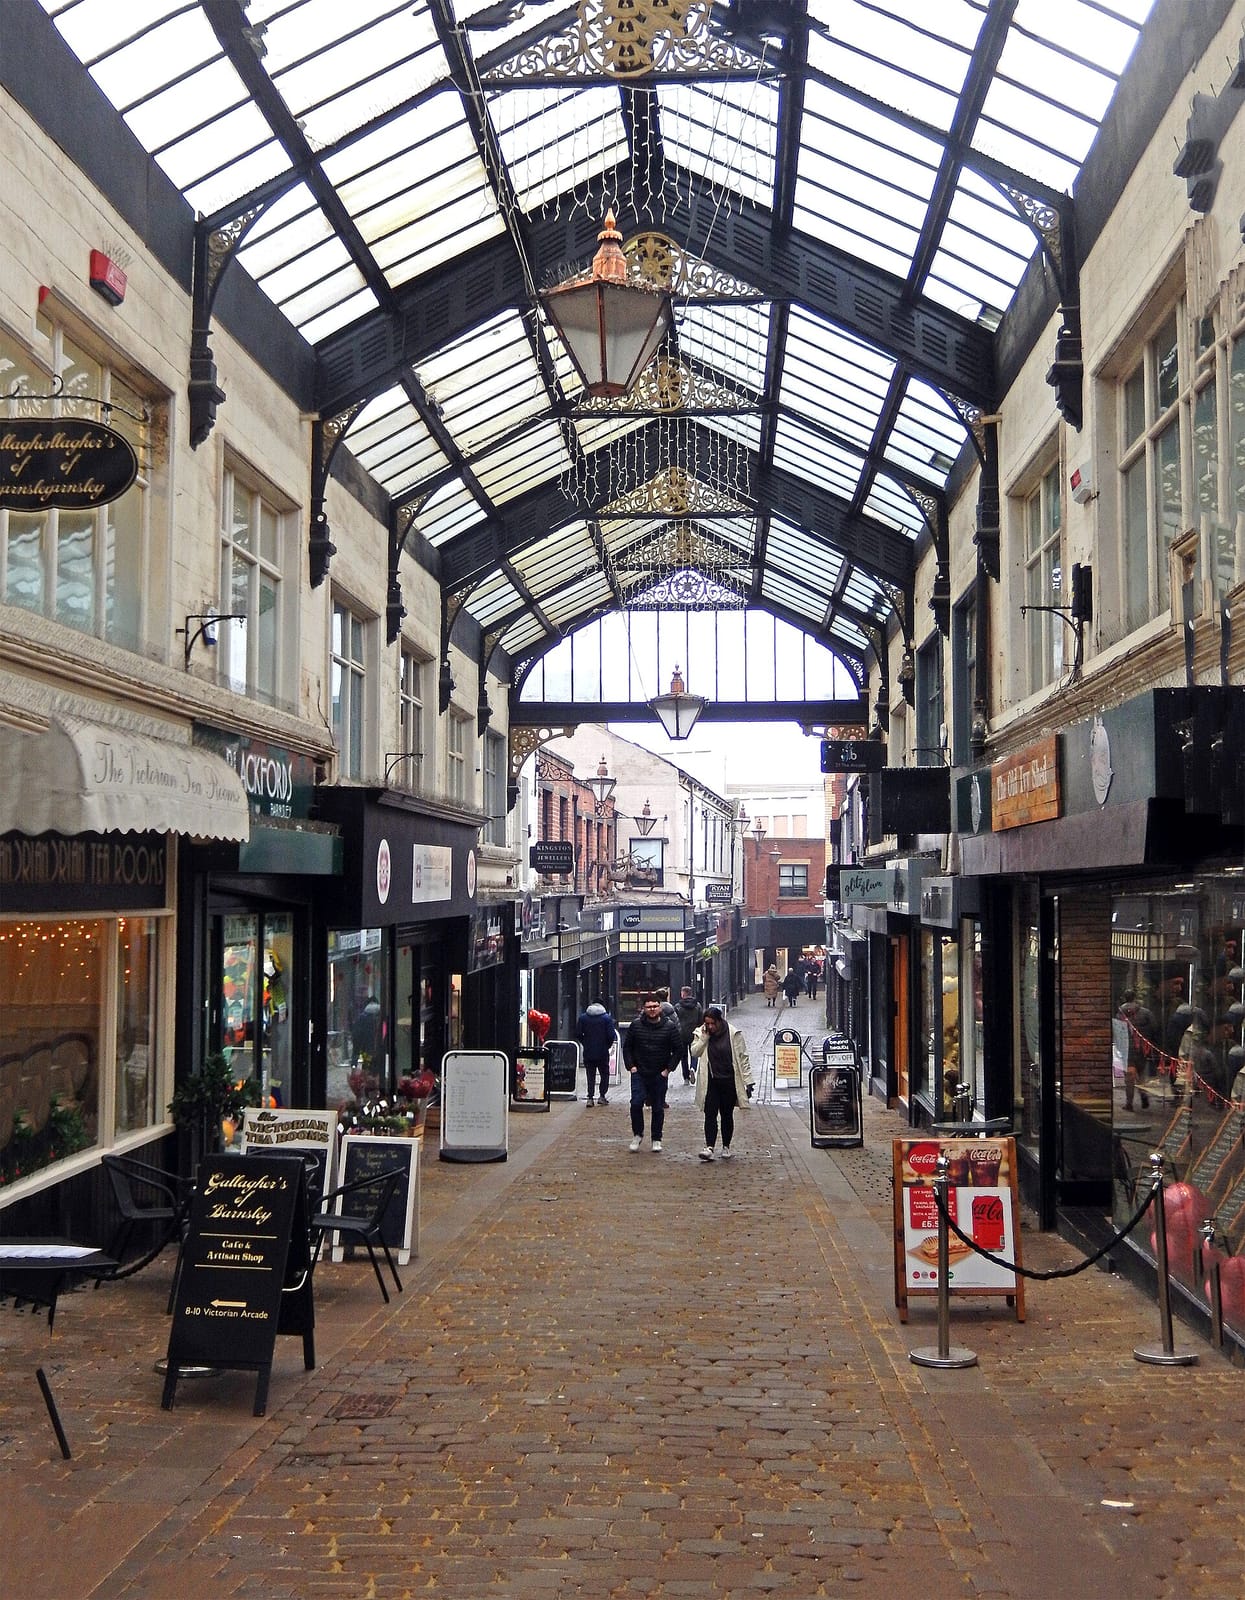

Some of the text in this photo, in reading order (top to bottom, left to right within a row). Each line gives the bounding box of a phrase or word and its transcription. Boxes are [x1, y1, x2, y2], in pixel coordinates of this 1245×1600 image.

[94, 741, 124, 784] The
[248, 1119, 329, 1133] VICTORIAN
[245, 1130, 330, 1144] TEA ROOMS
[204, 1172, 288, 1196] Gallagher's
[234, 1190, 255, 1208] of
[205, 1203, 272, 1225] Barnsley
[207, 1251, 264, 1264] Artisan Shop
[185, 1306, 269, 1320] 8-10 Victorian Arcade
